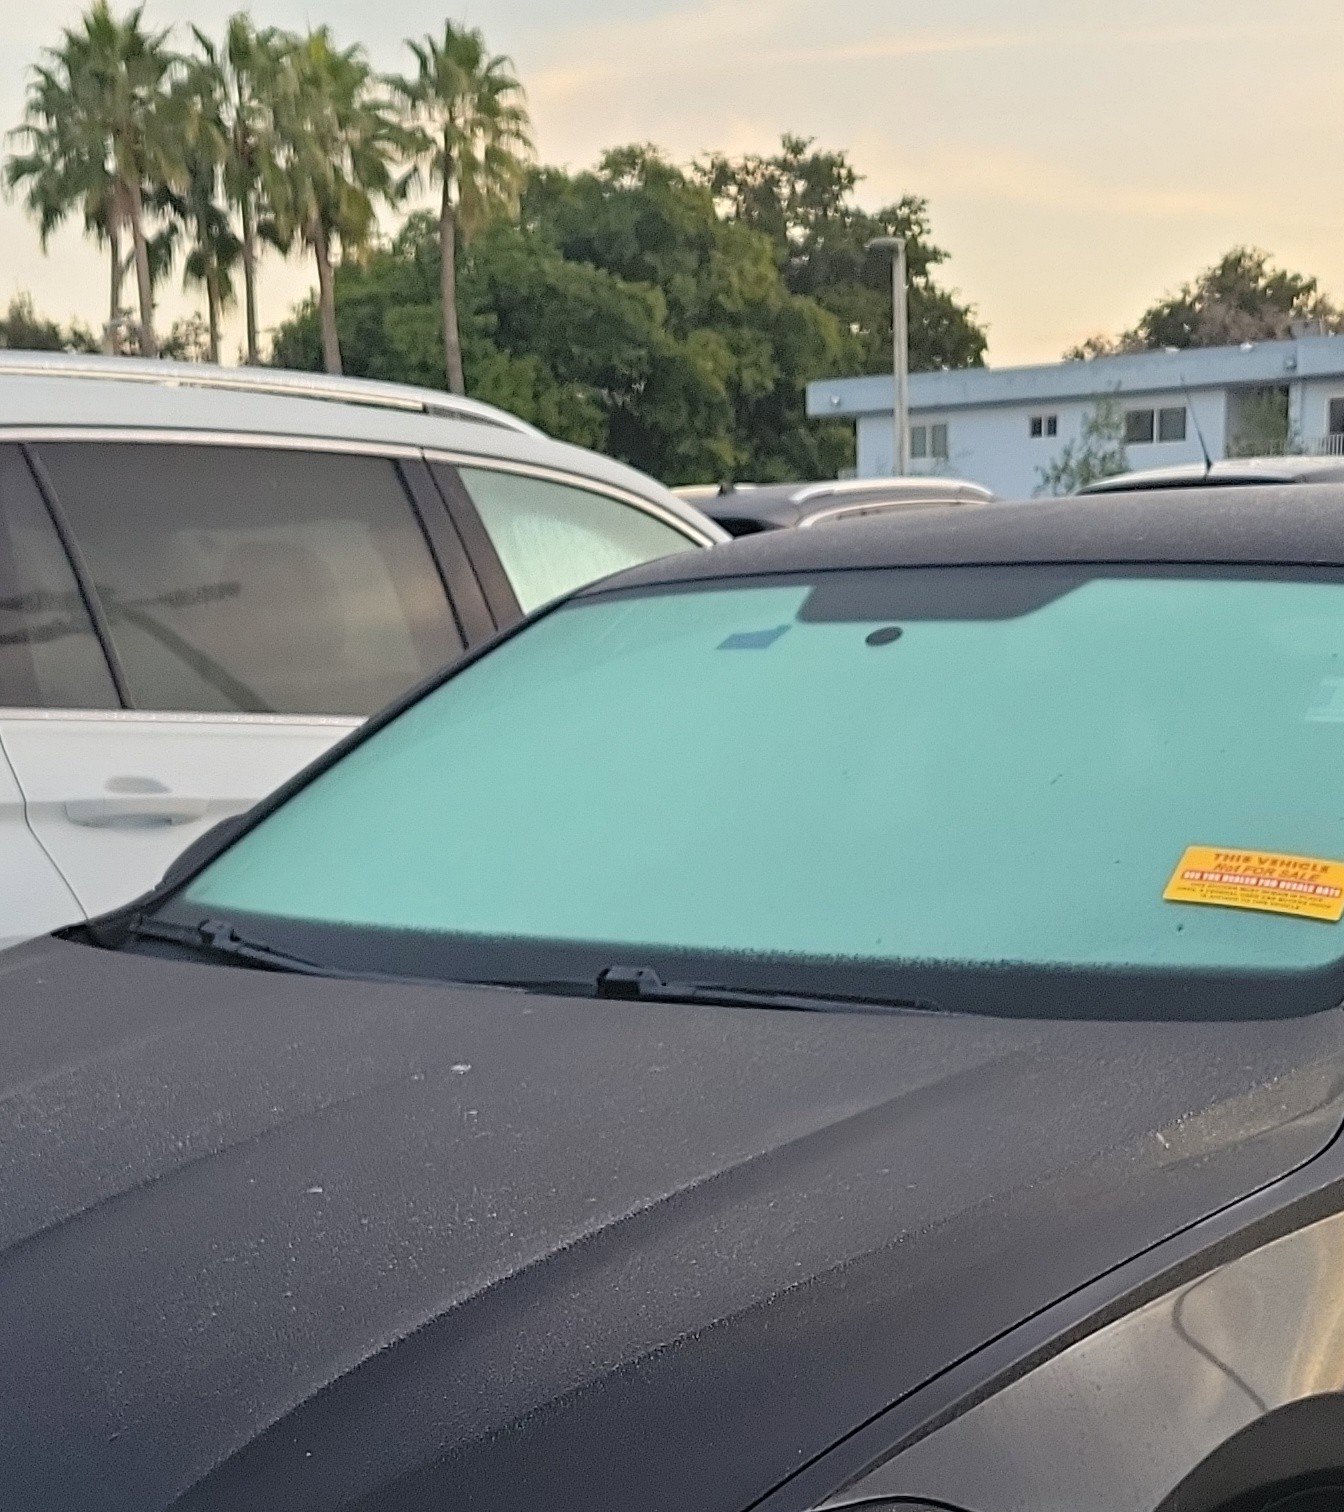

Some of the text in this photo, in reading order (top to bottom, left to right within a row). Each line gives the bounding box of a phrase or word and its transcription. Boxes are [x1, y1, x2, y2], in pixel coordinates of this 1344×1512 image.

[1213, 853, 1330, 873] THIS VEHICLE
[1242, 865, 1278, 877] FOR
[1278, 869, 1321, 882] SALE
